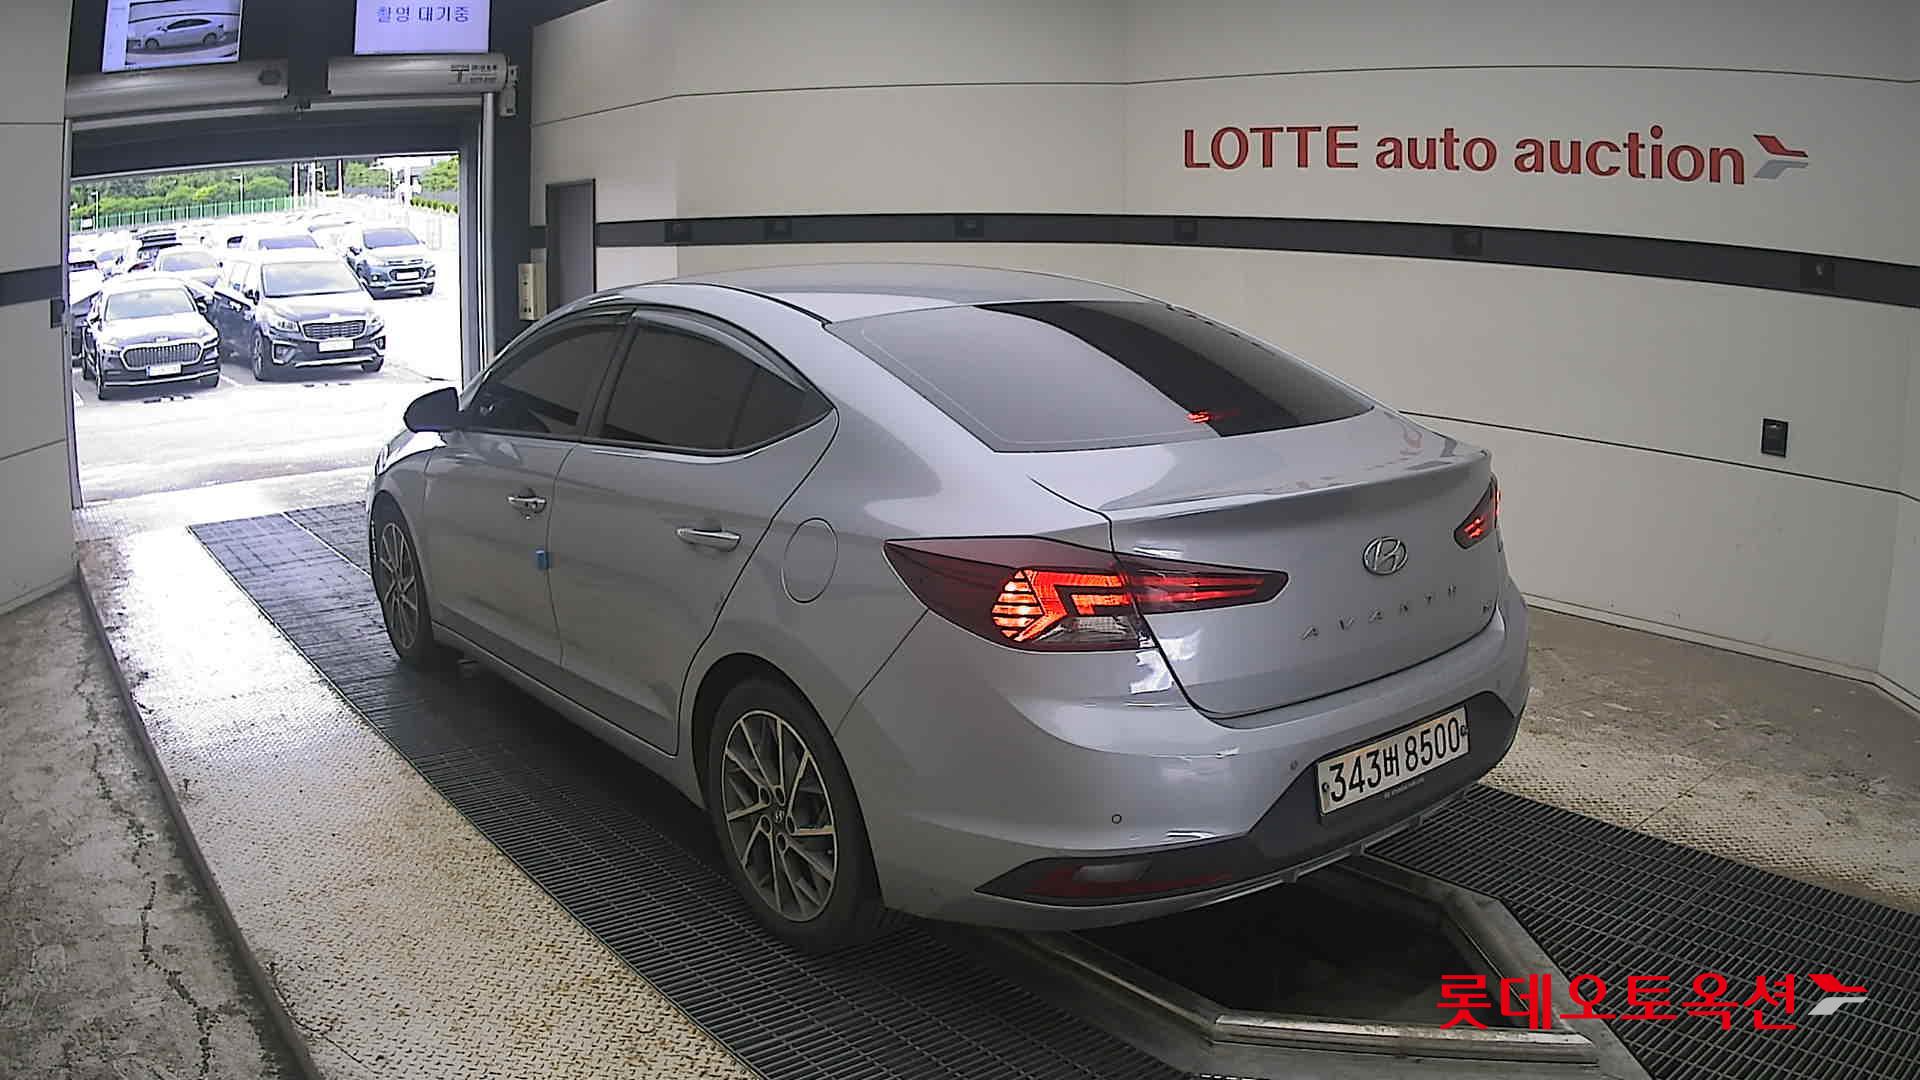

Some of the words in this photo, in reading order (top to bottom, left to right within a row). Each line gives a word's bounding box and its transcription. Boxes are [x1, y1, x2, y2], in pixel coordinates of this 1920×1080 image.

[418, 6, 469, 23] 대기중
[1184, 126, 1359, 170] LOTTE
[1375, 127, 1497, 172] auto
[1513, 124, 1745, 186] auction
